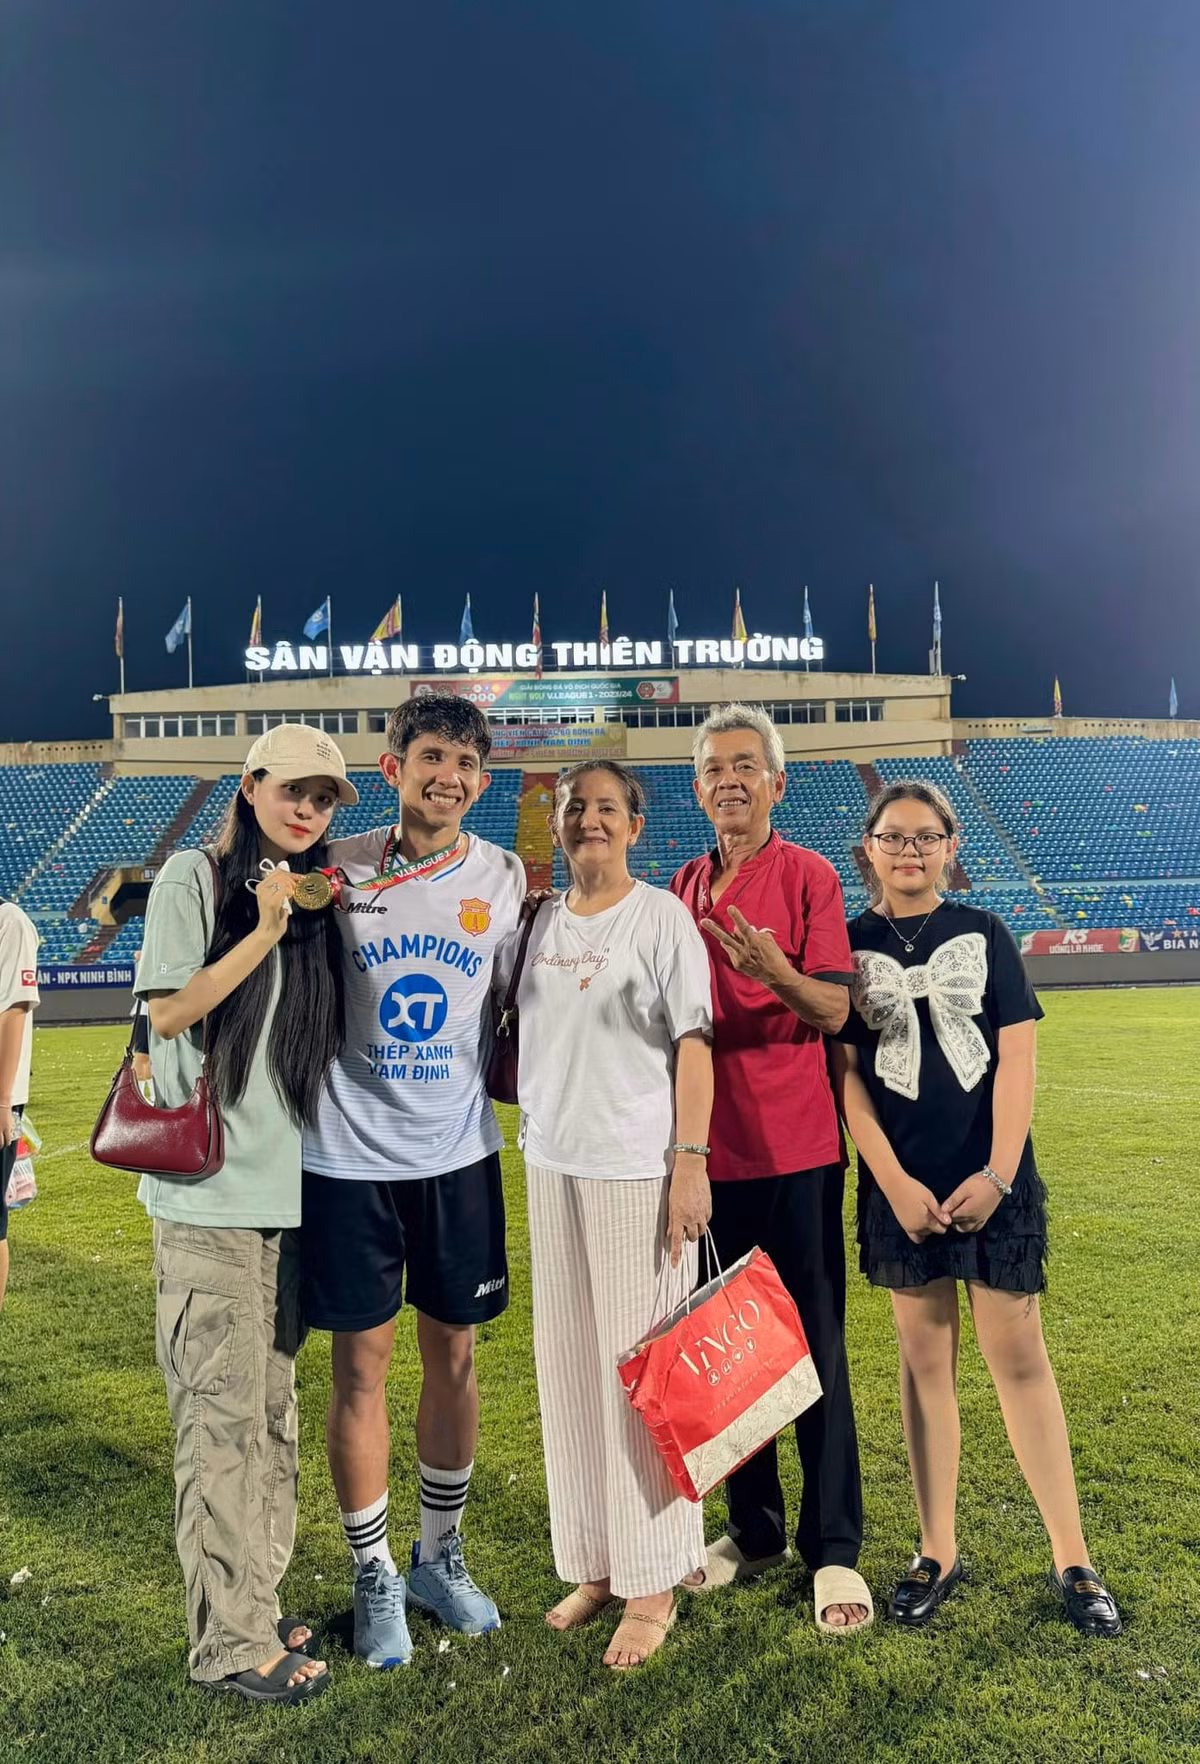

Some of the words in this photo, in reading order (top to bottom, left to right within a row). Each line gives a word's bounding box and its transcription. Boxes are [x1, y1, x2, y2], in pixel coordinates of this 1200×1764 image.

[245, 641, 328, 671] SÂN
[340, 640, 418, 675] VẬN
[432, 638, 538, 673] ĐỘNG
[551, 636, 662, 666] THIÊN
[395, 852, 445, 879] V.LEAGUE
[346, 892, 388, 915] Mitre
[1163, 939, 1187, 949] BIA
[1189, 938, 1200, 949] N
[352, 933, 483, 978] CHAMPIONS
[57, 970, 79, 985] NPK
[80, 970, 105, 984] NINH
[106, 967, 132, 983] BÌNH
[366, 1041, 410, 1060] THÉP
[414, 1044, 453, 1061] XANH
[412, 1063, 450, 1084] ĐỊNH
